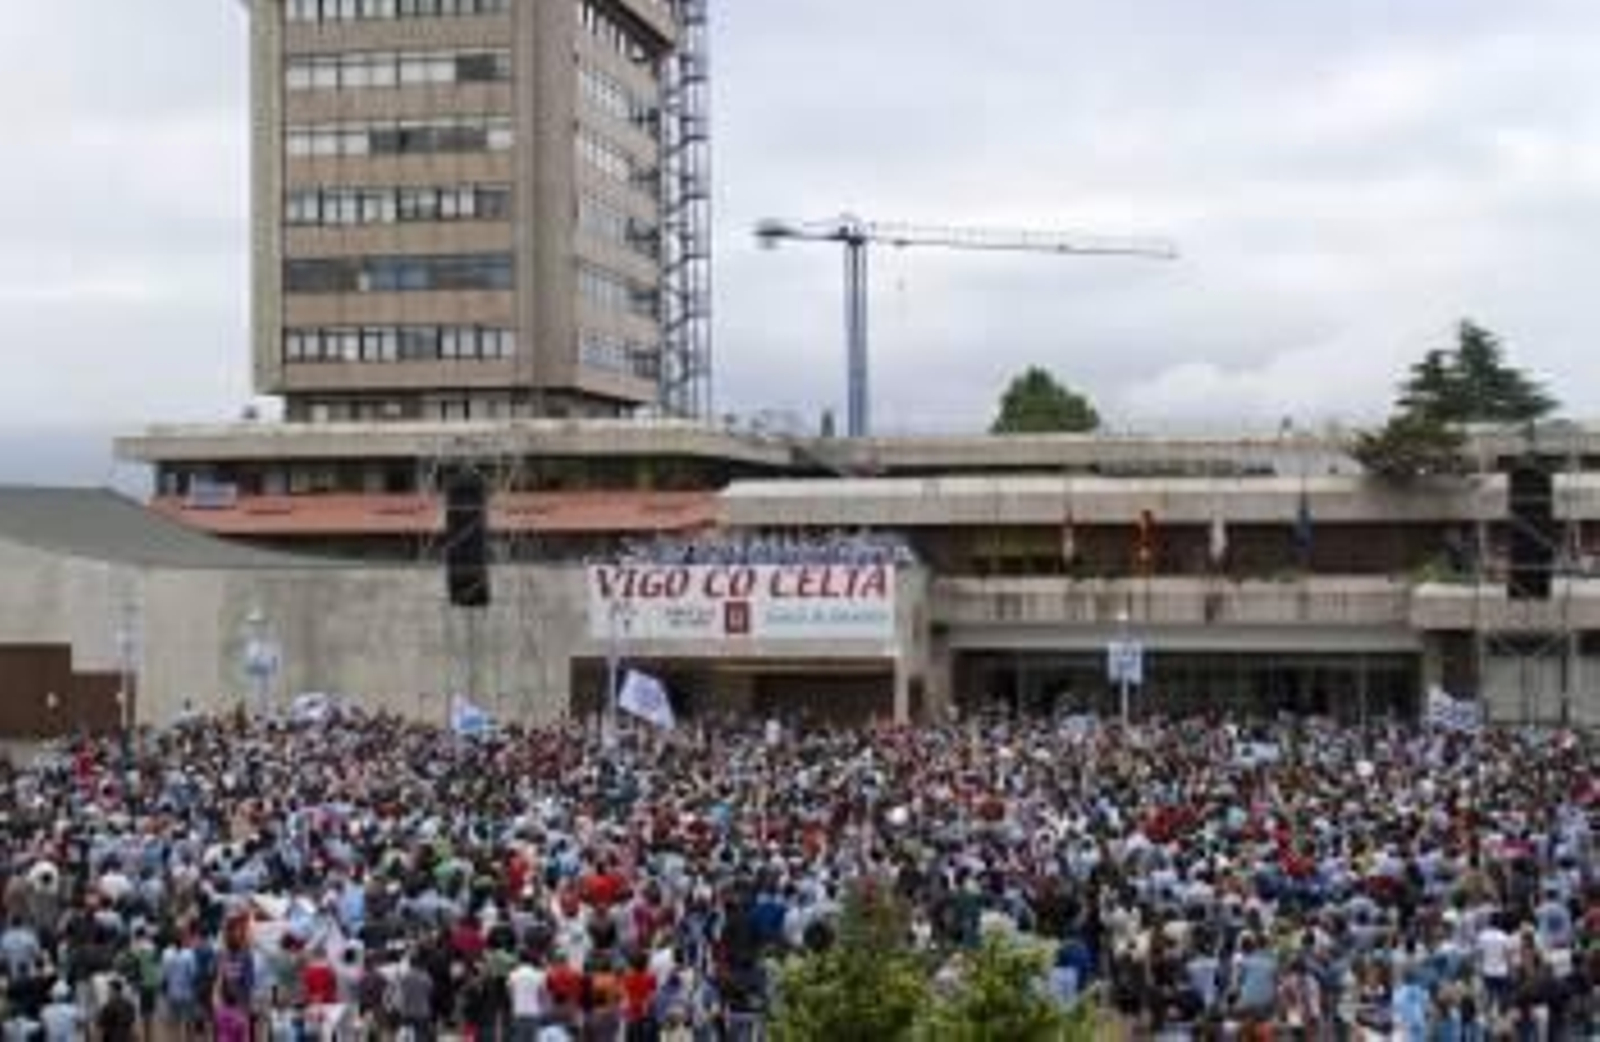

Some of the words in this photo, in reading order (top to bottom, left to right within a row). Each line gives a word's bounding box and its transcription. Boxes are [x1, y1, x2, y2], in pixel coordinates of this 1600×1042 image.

[596, 568, 690, 599] VIGO
[703, 567, 757, 598] CO
[770, 566, 887, 598] CELTA
